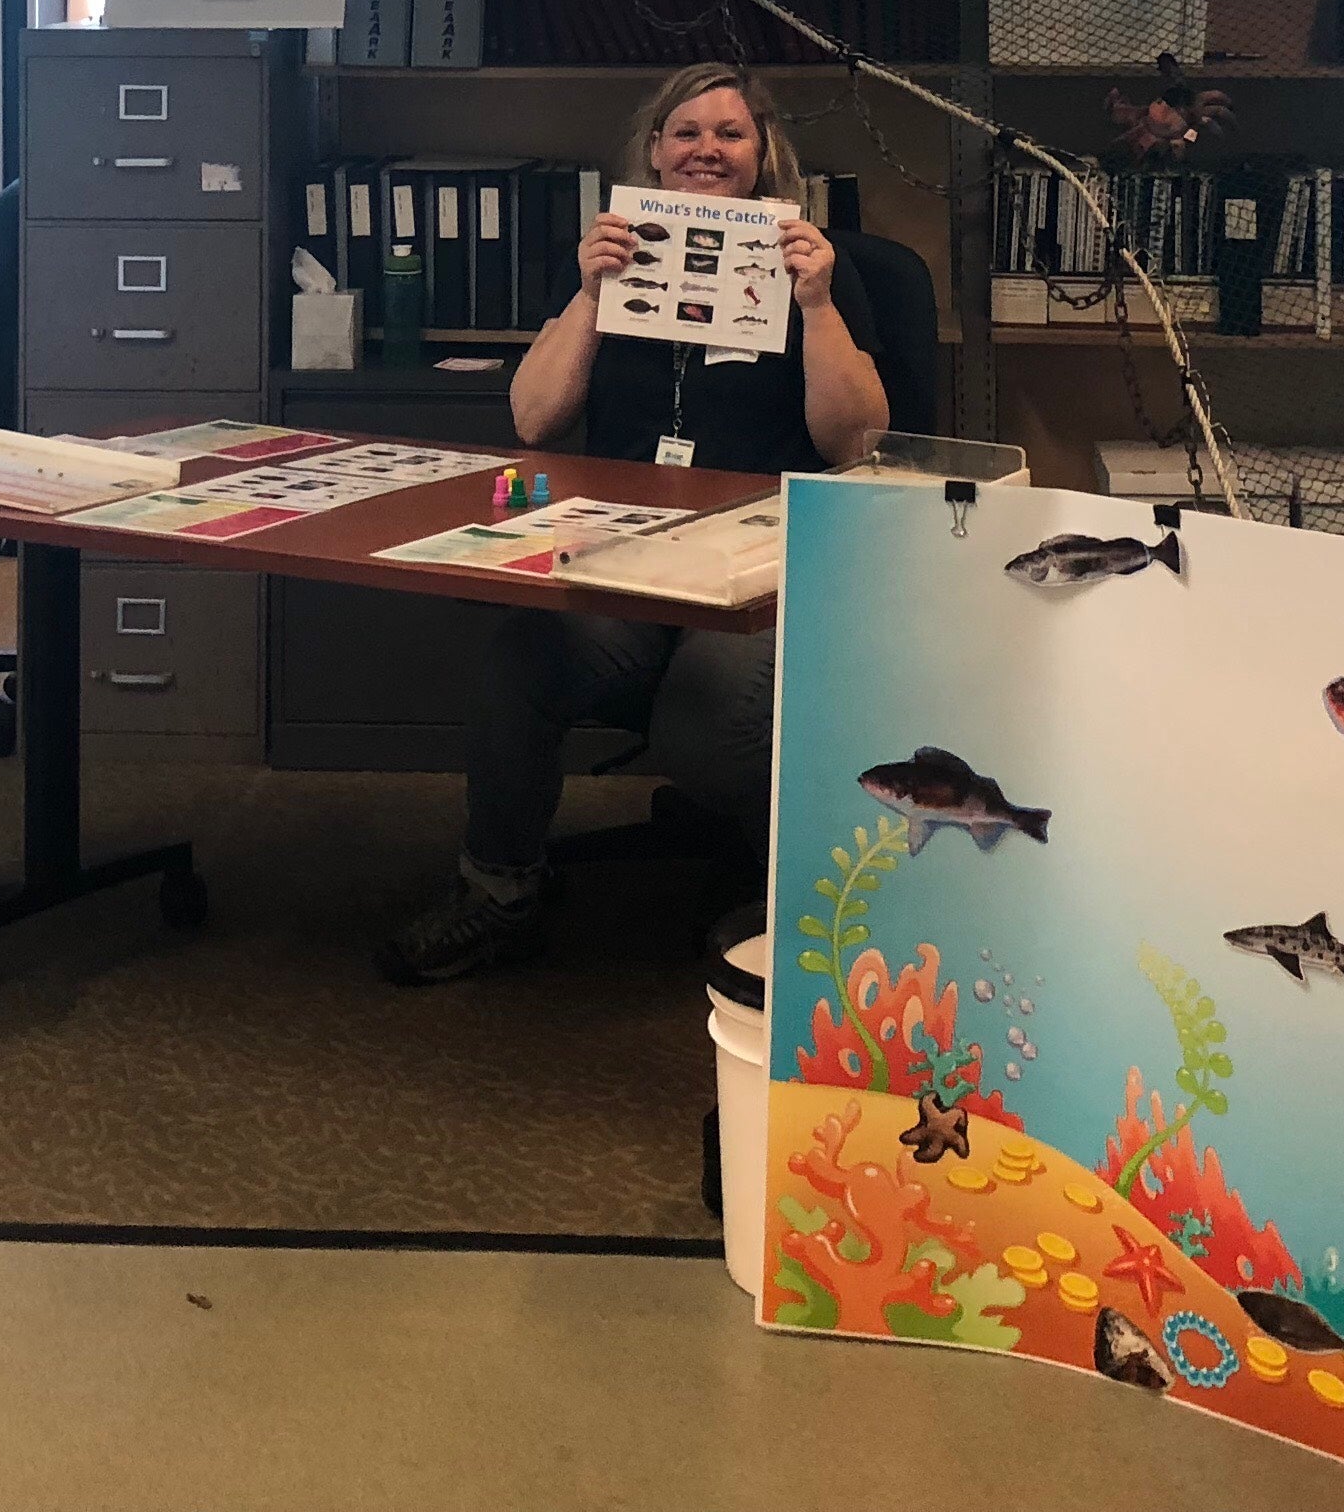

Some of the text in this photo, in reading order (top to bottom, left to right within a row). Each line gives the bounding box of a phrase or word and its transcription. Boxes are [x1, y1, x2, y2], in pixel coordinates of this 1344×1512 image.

[640, 199, 776, 225] What's the Catch?
